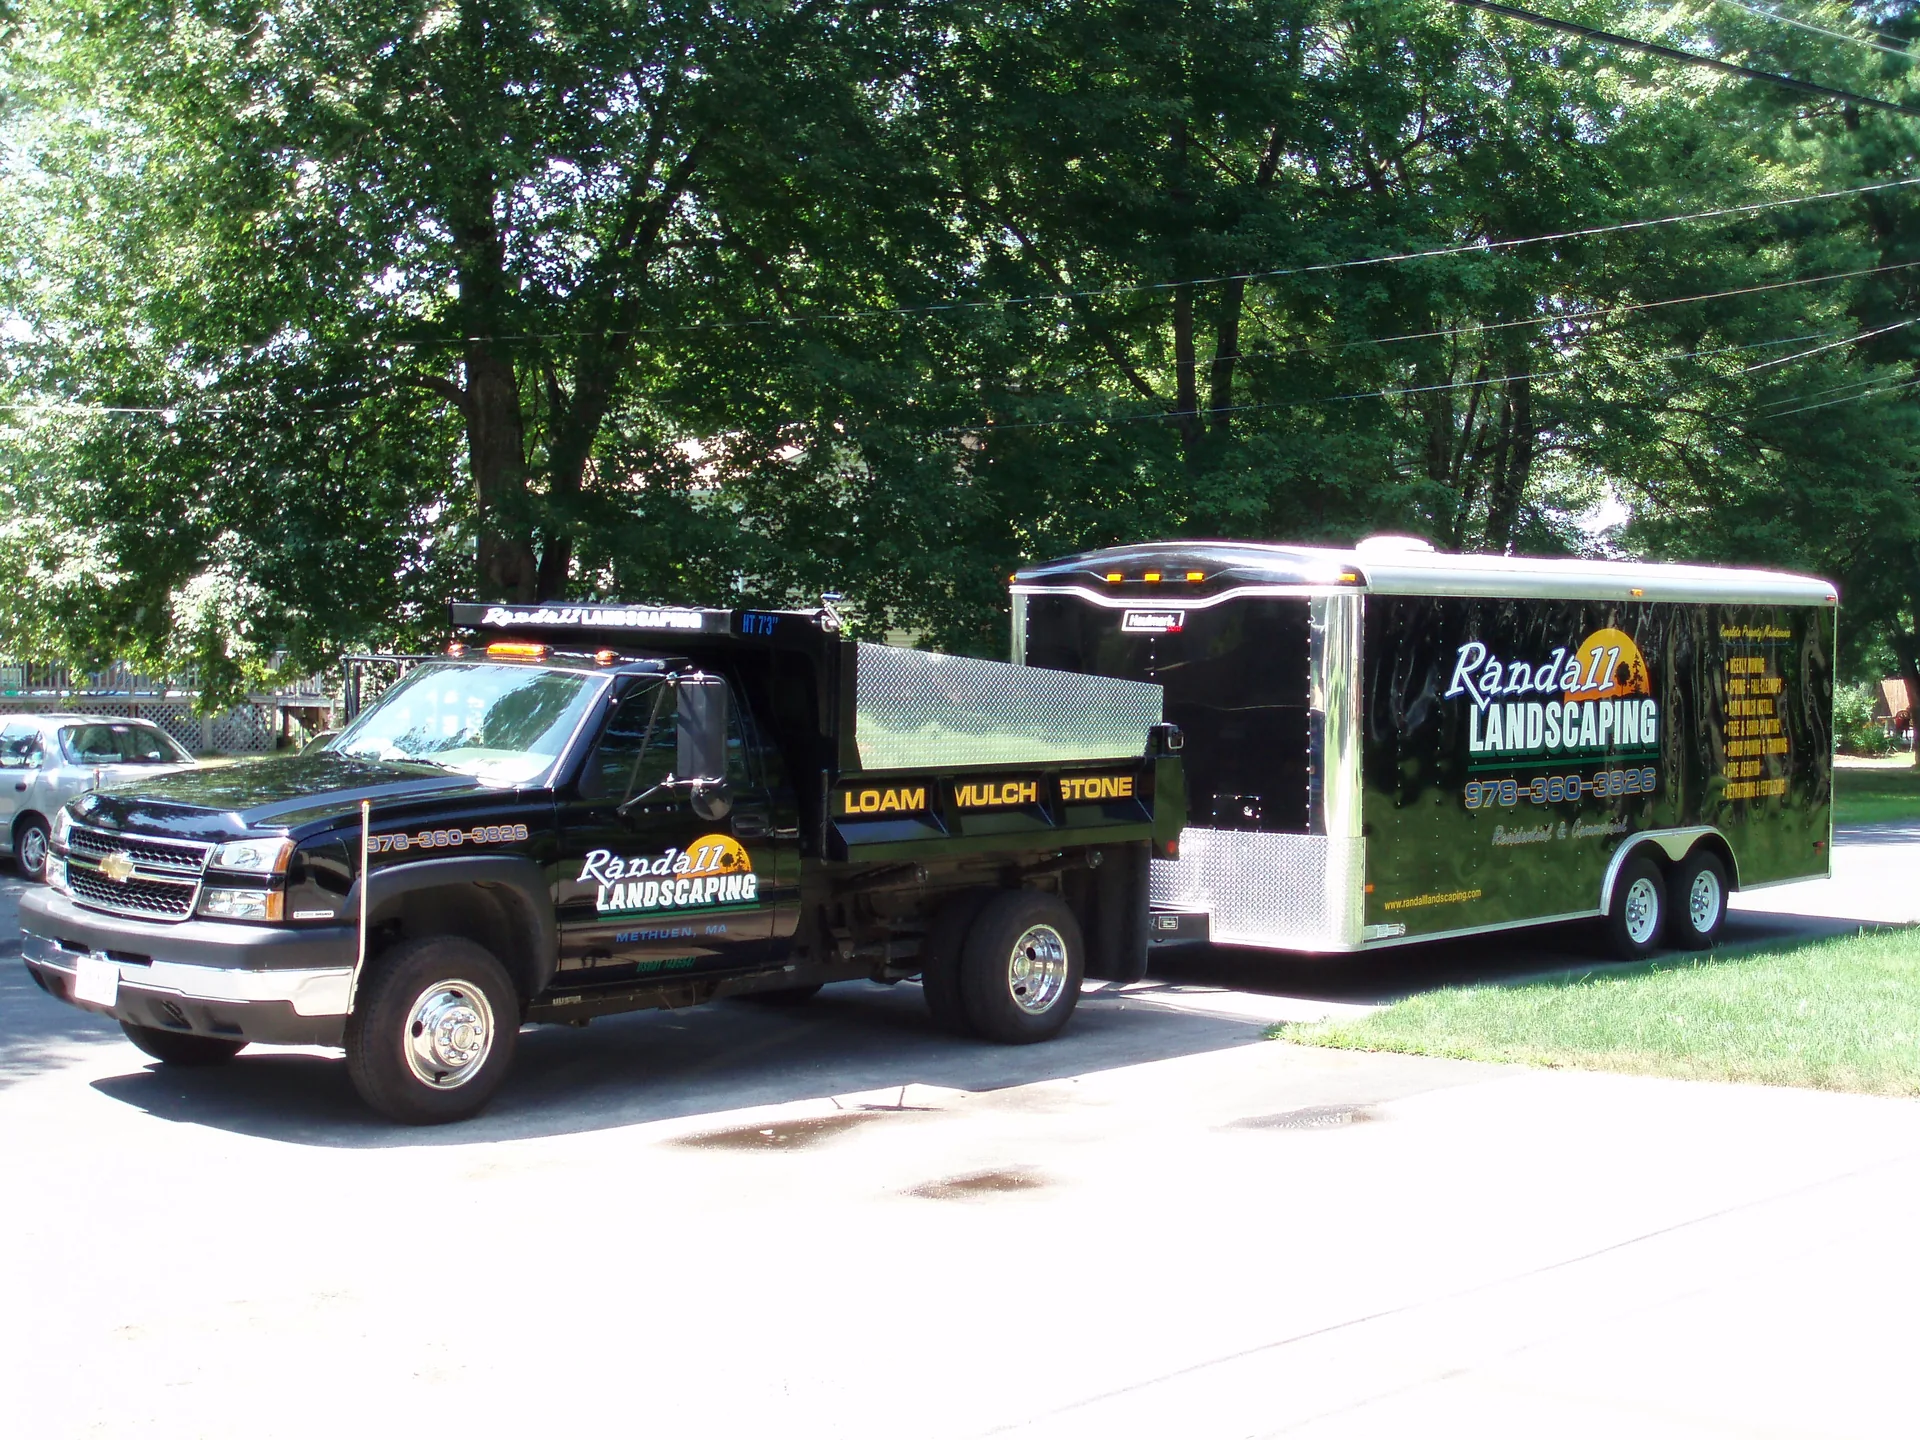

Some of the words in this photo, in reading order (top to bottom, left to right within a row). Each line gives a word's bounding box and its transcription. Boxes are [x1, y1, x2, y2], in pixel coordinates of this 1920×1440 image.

[742, 613, 756, 634] HT
[1444, 641, 1621, 711] Randall
[1469, 699, 1657, 755] LANDSCAPING
[845, 788, 925, 813] LOAM
[954, 782, 1036, 808] MULCH
[1059, 776, 1133, 800] STONE
[1465, 767, 1657, 809] 978-360-3826
[367, 823, 529, 853] 978-360-3826
[576, 845, 724, 888] Randall
[596, 874, 758, 912] LANDSCAPING
[615, 927, 697, 943] METHUEN,
[705, 924, 727, 936] MA
